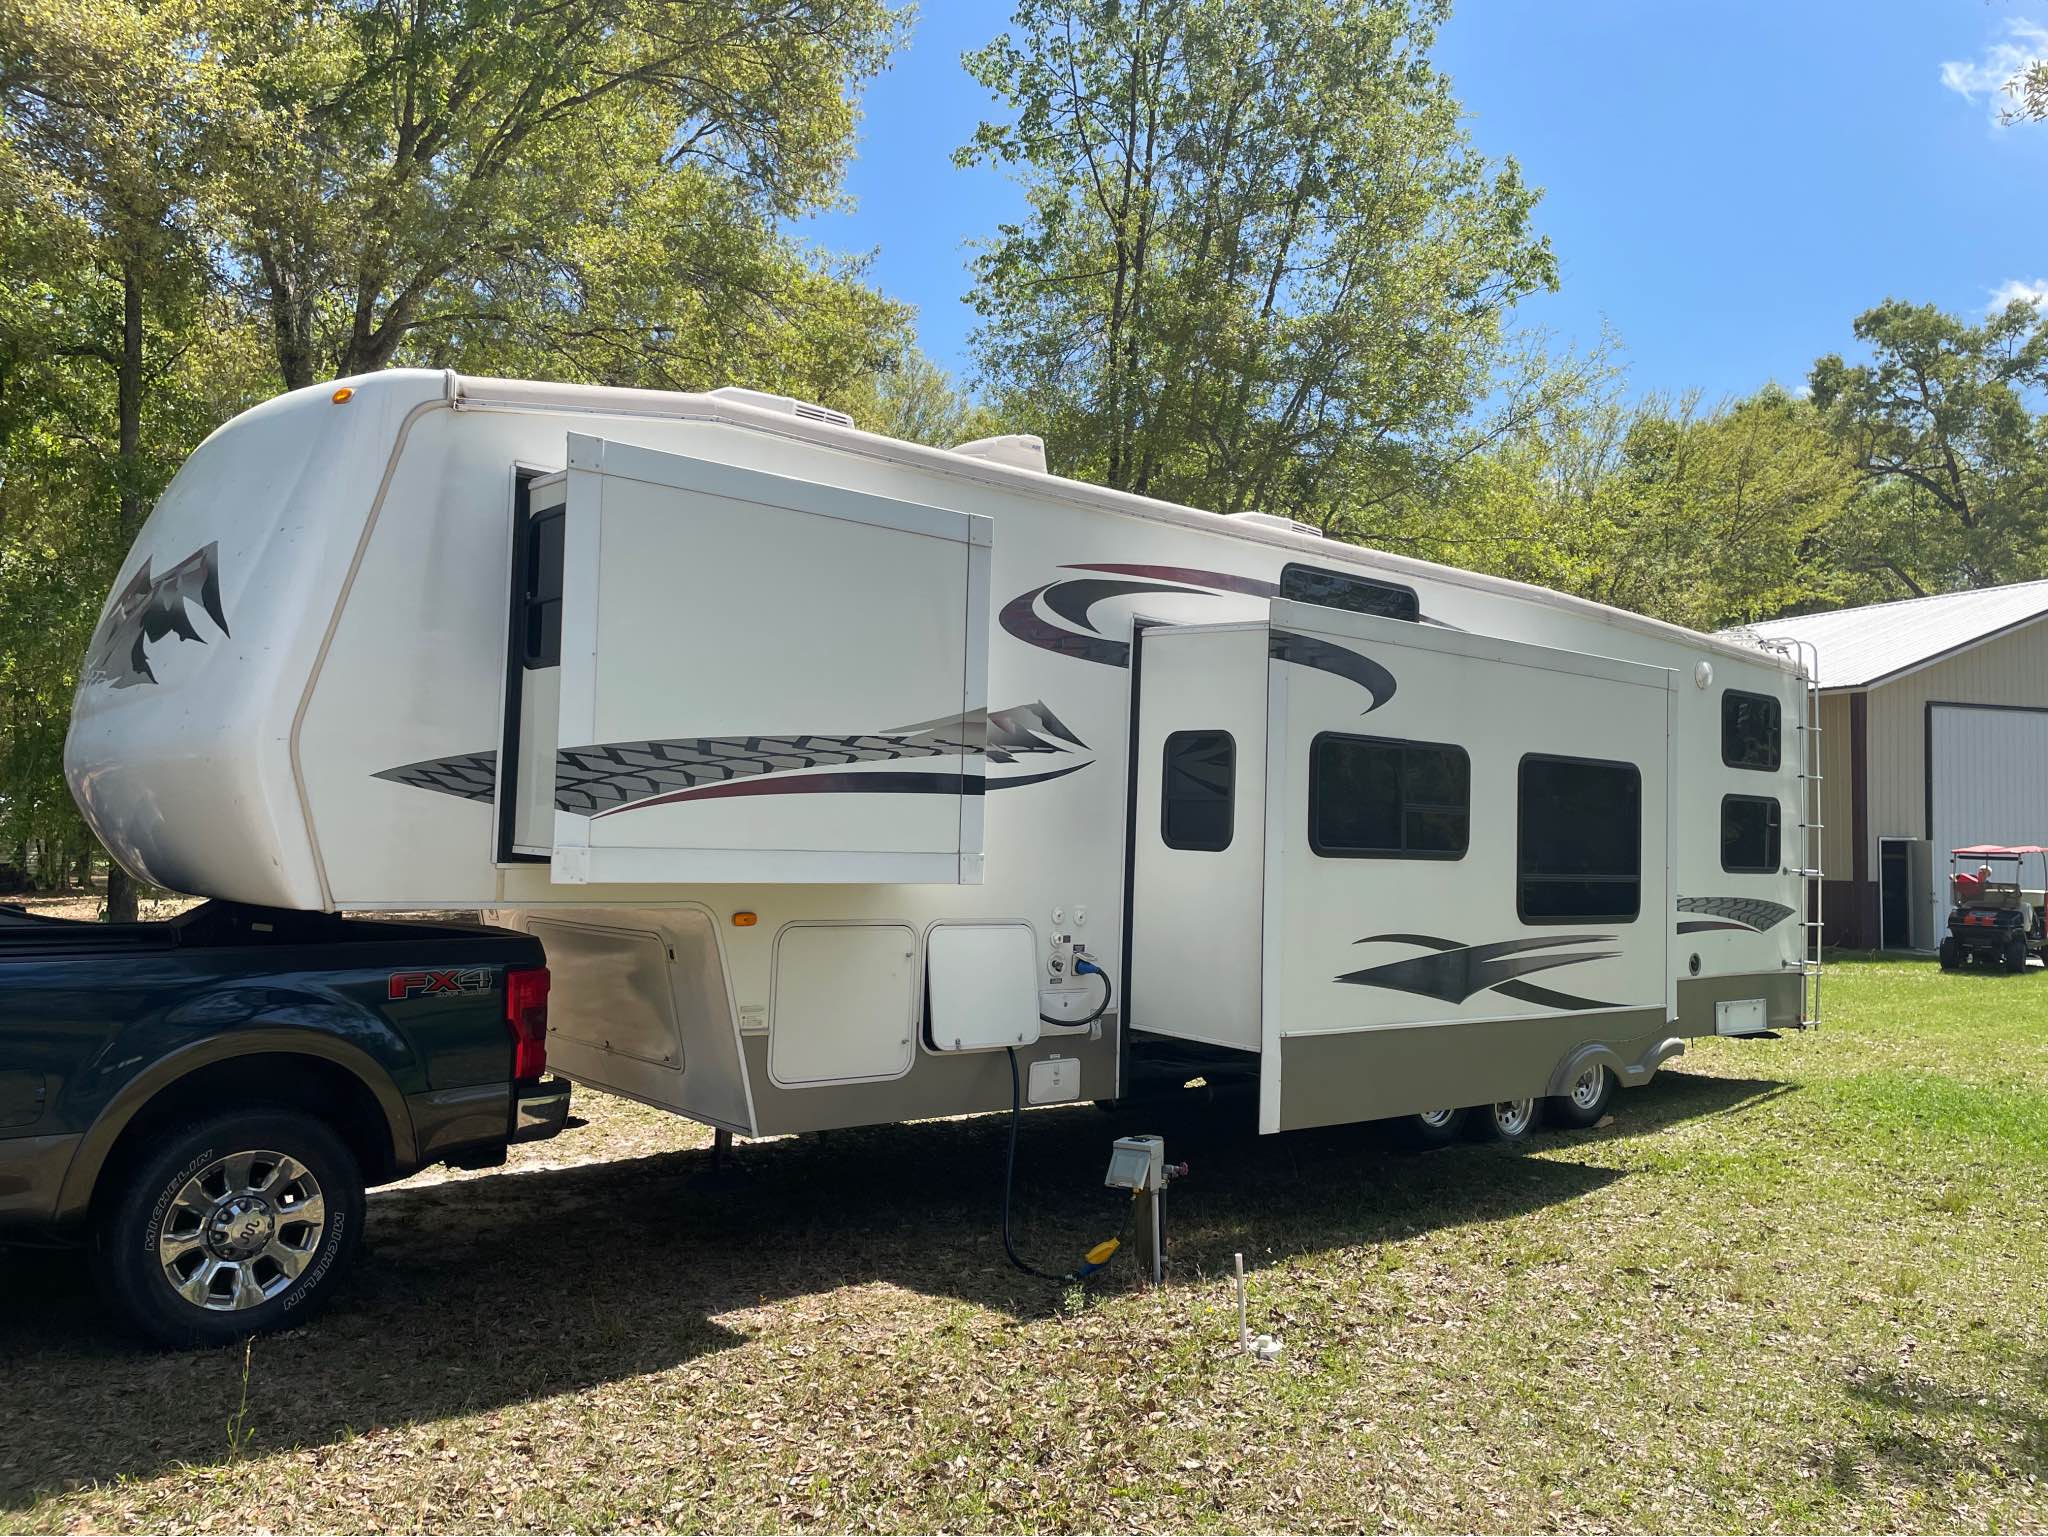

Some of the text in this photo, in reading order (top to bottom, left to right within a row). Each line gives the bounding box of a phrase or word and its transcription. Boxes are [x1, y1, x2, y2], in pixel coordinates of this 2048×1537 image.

[389, 968, 492, 1000] FX4
[144, 1149, 213, 1251] MICHELIN
[283, 1212, 345, 1311] MICHELIN
